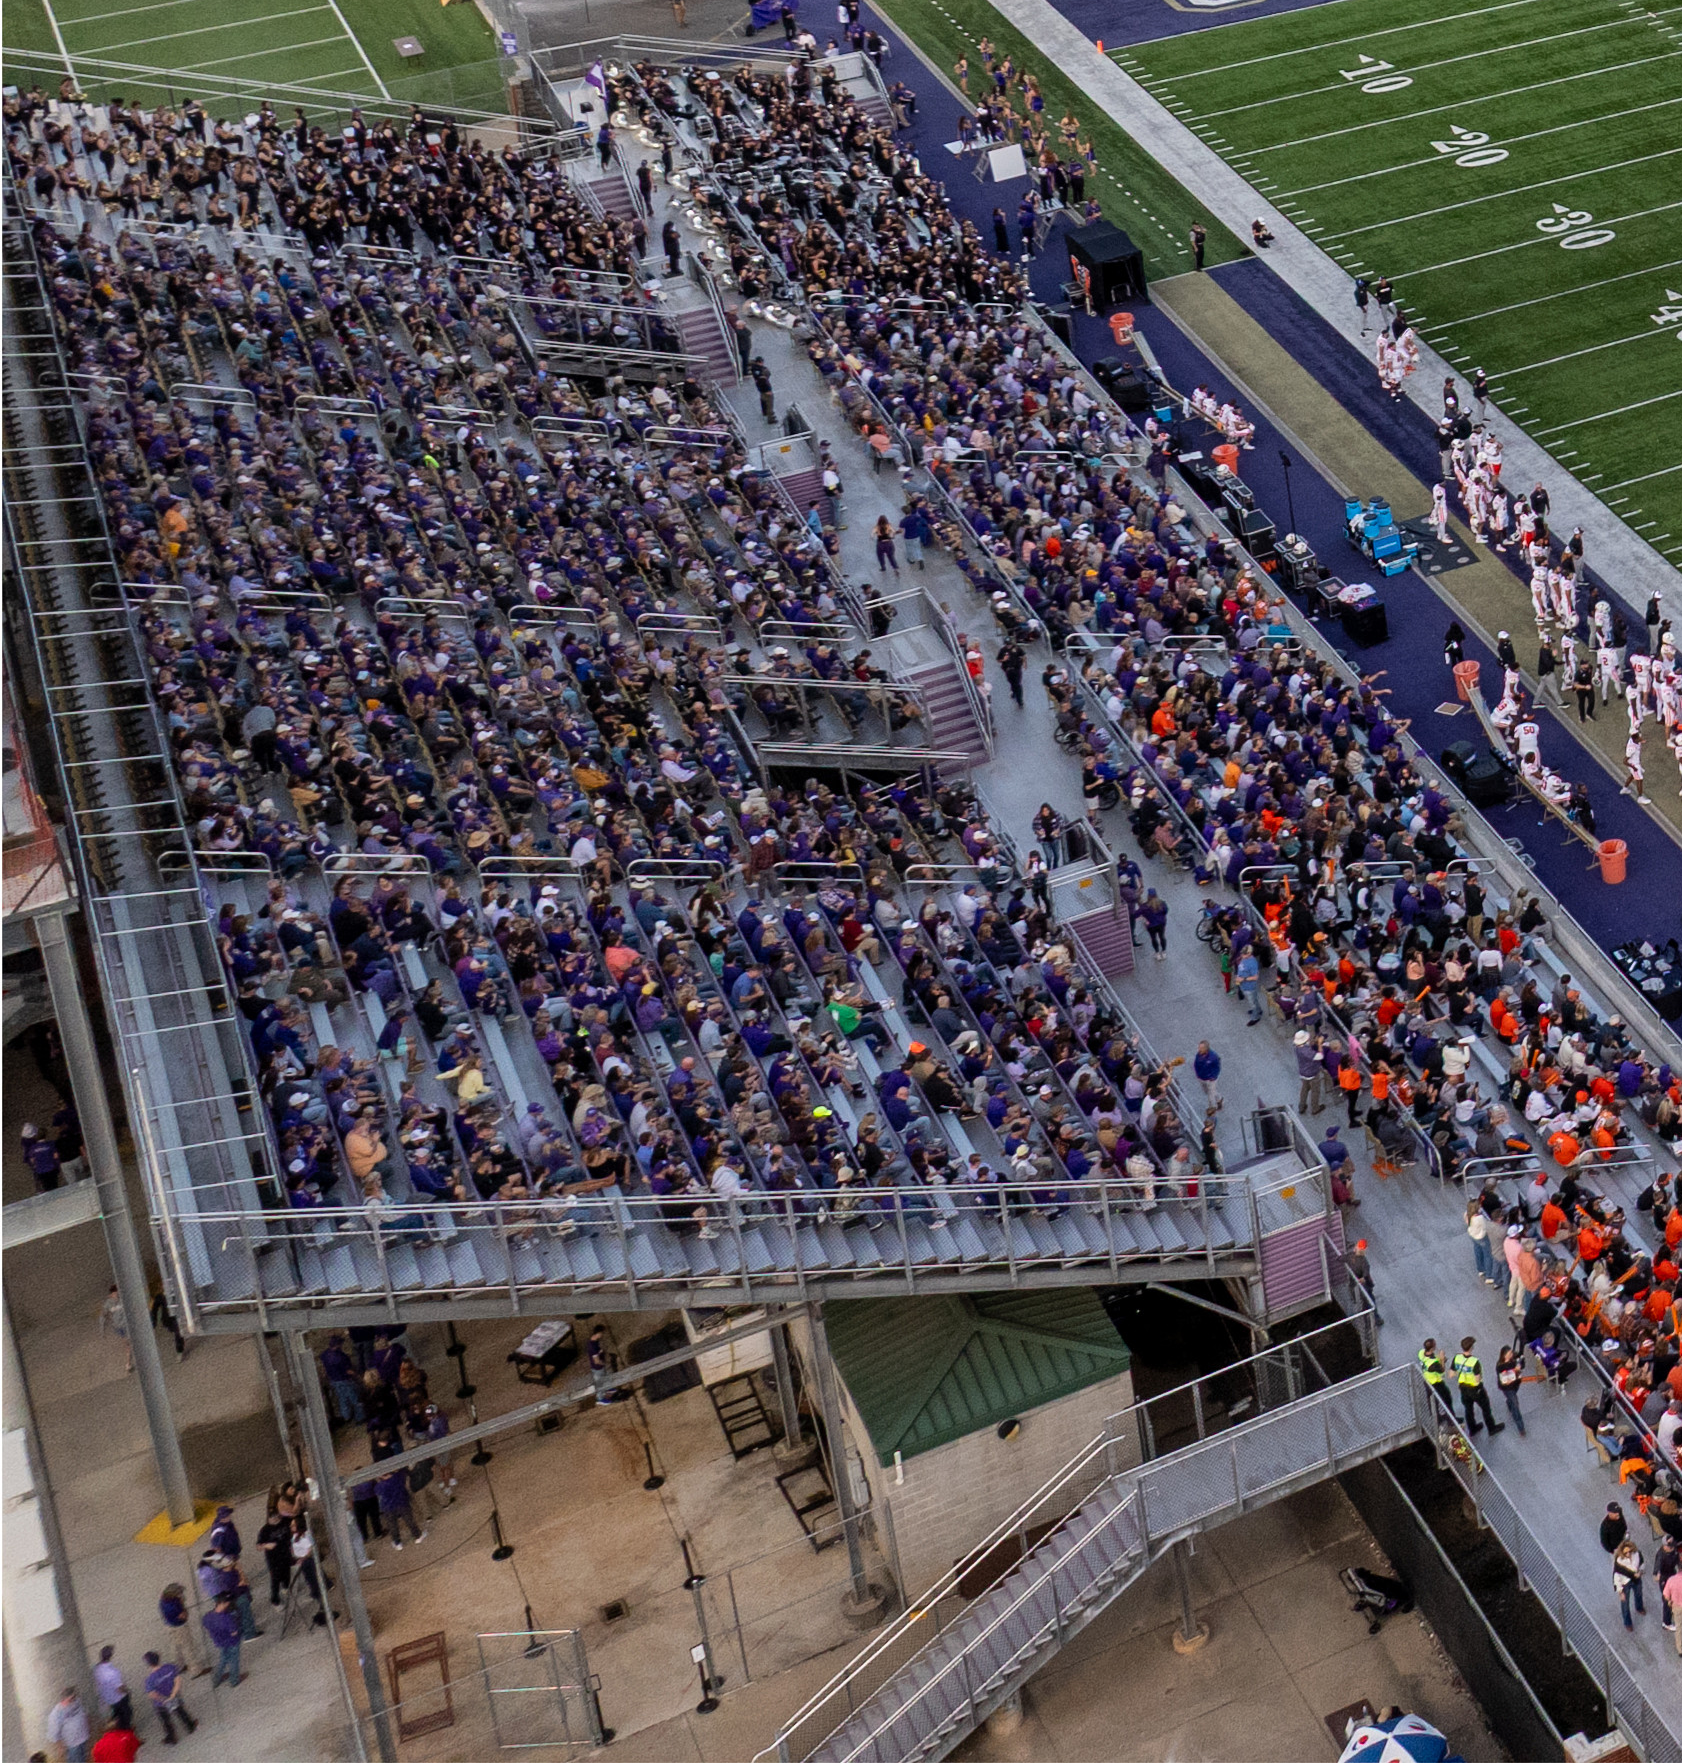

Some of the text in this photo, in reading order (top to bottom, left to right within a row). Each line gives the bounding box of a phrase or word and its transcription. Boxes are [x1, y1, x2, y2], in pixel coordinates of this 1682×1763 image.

[1339, 61, 1414, 94] 10
[1430, 130, 1510, 168] 20
[1536, 210, 1617, 250] 30
[1521, 725, 1534, 735] 50
